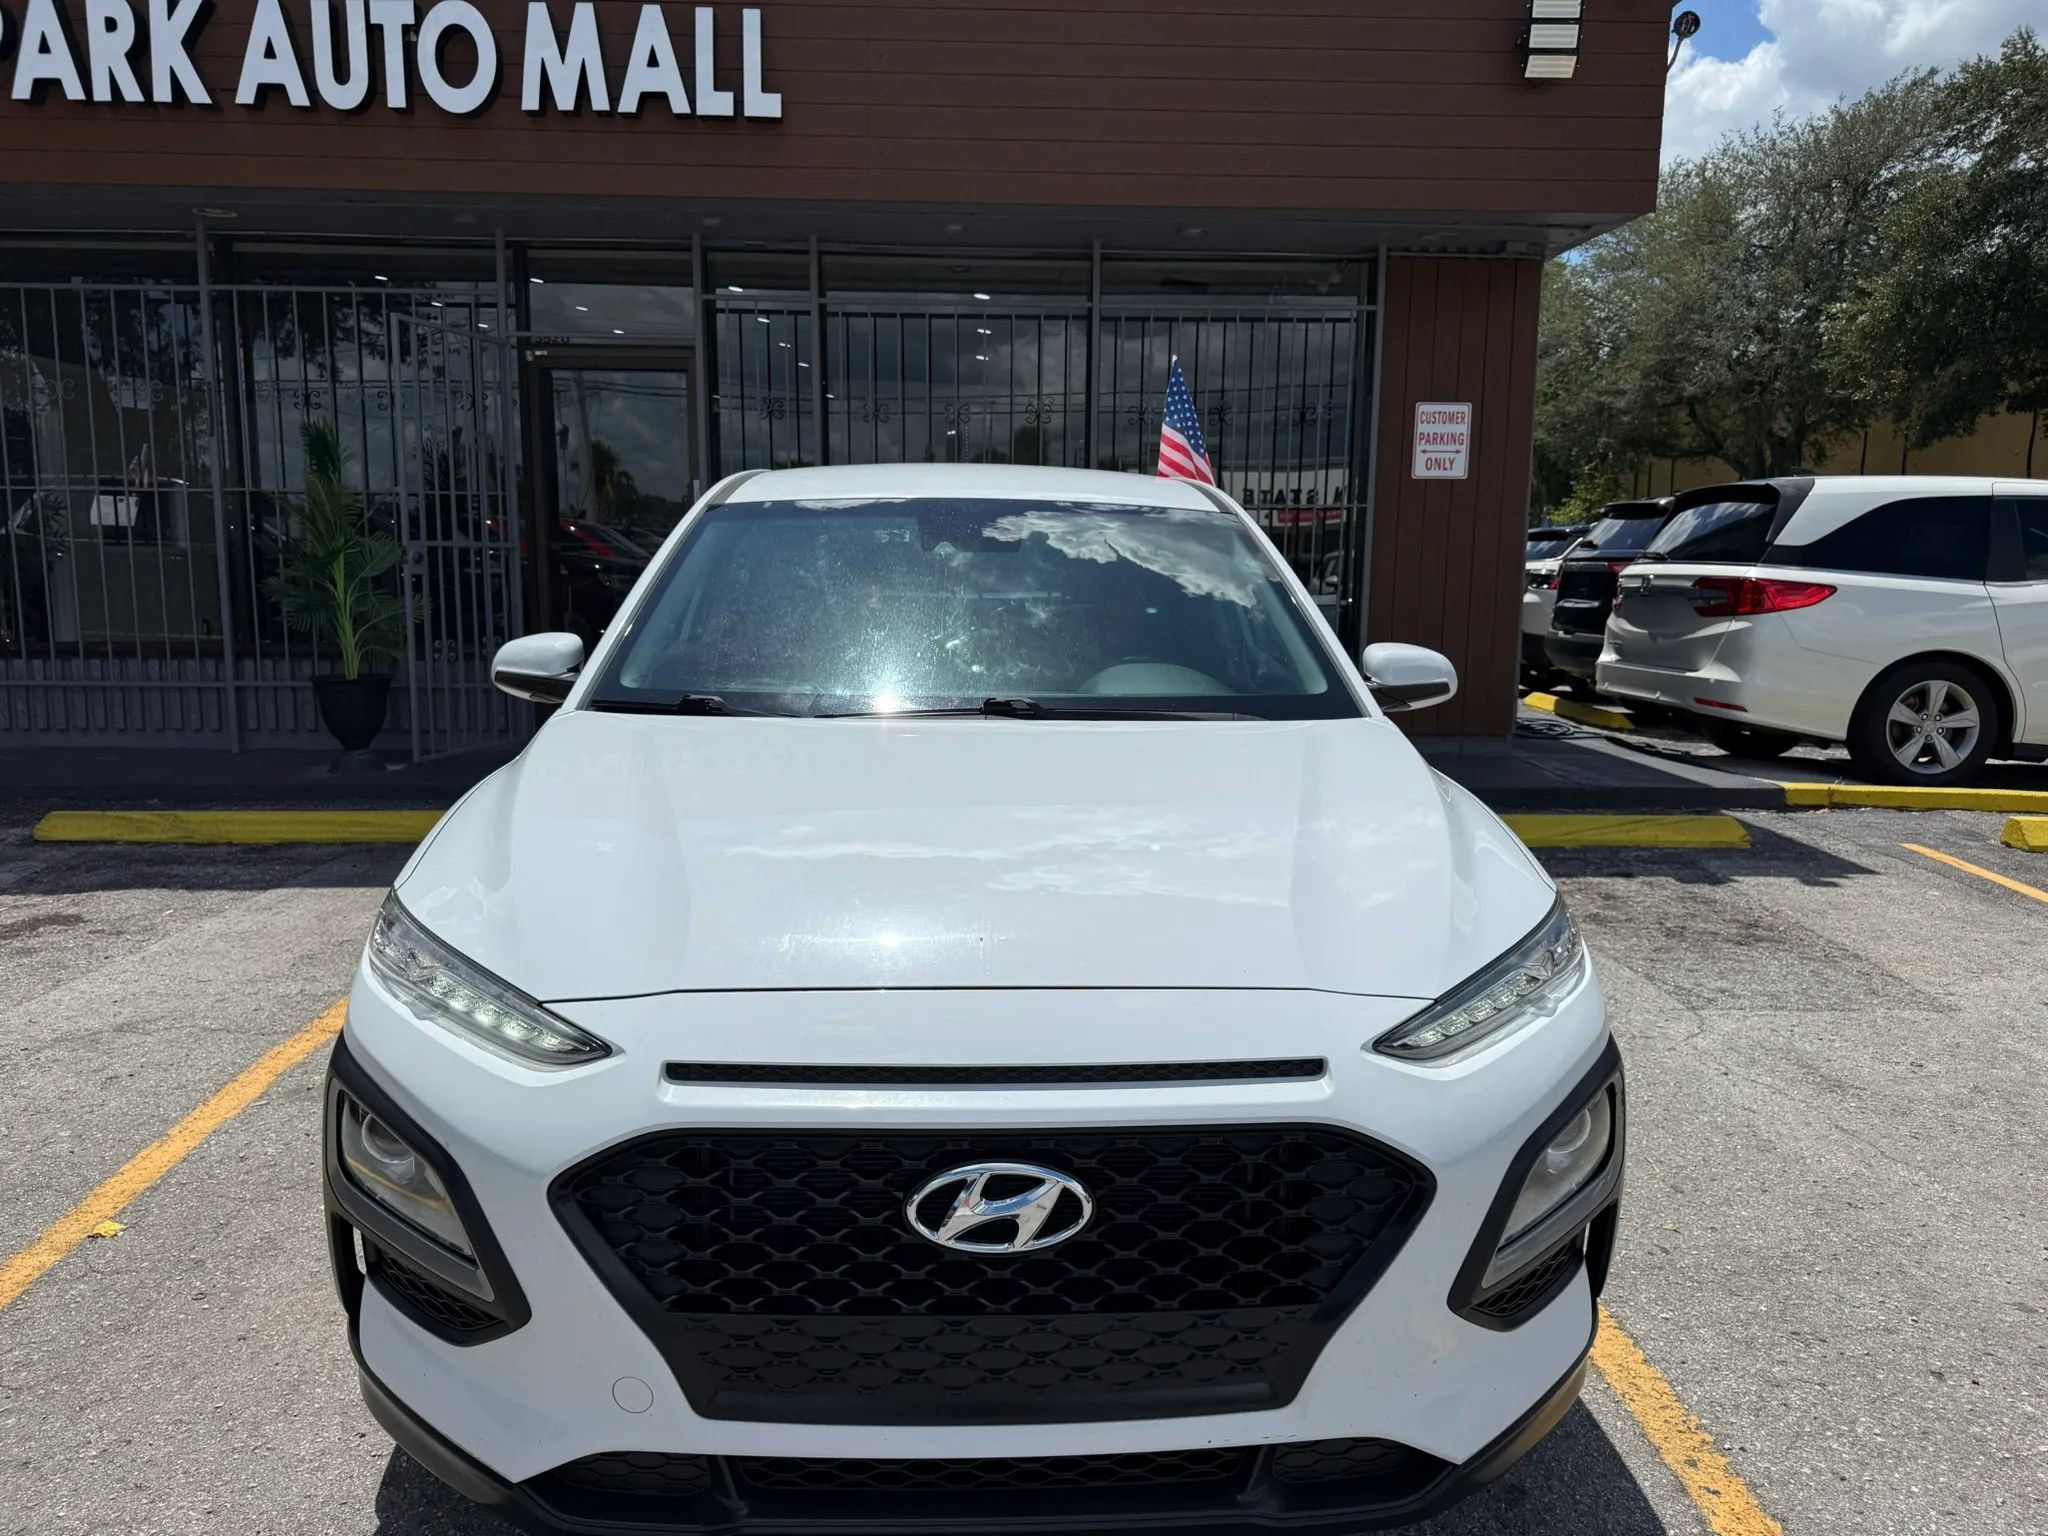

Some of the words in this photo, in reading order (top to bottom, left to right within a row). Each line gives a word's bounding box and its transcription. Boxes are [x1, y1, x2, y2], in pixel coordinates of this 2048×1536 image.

[0, 0, 213, 104] ARK
[235, 0, 497, 114] AUTO
[521, 2, 782, 118] MALL
[1419, 410, 1466, 425] CUSTOMER
[1418, 432, 1465, 446] PARKING
[1425, 457, 1456, 471] ONLY
